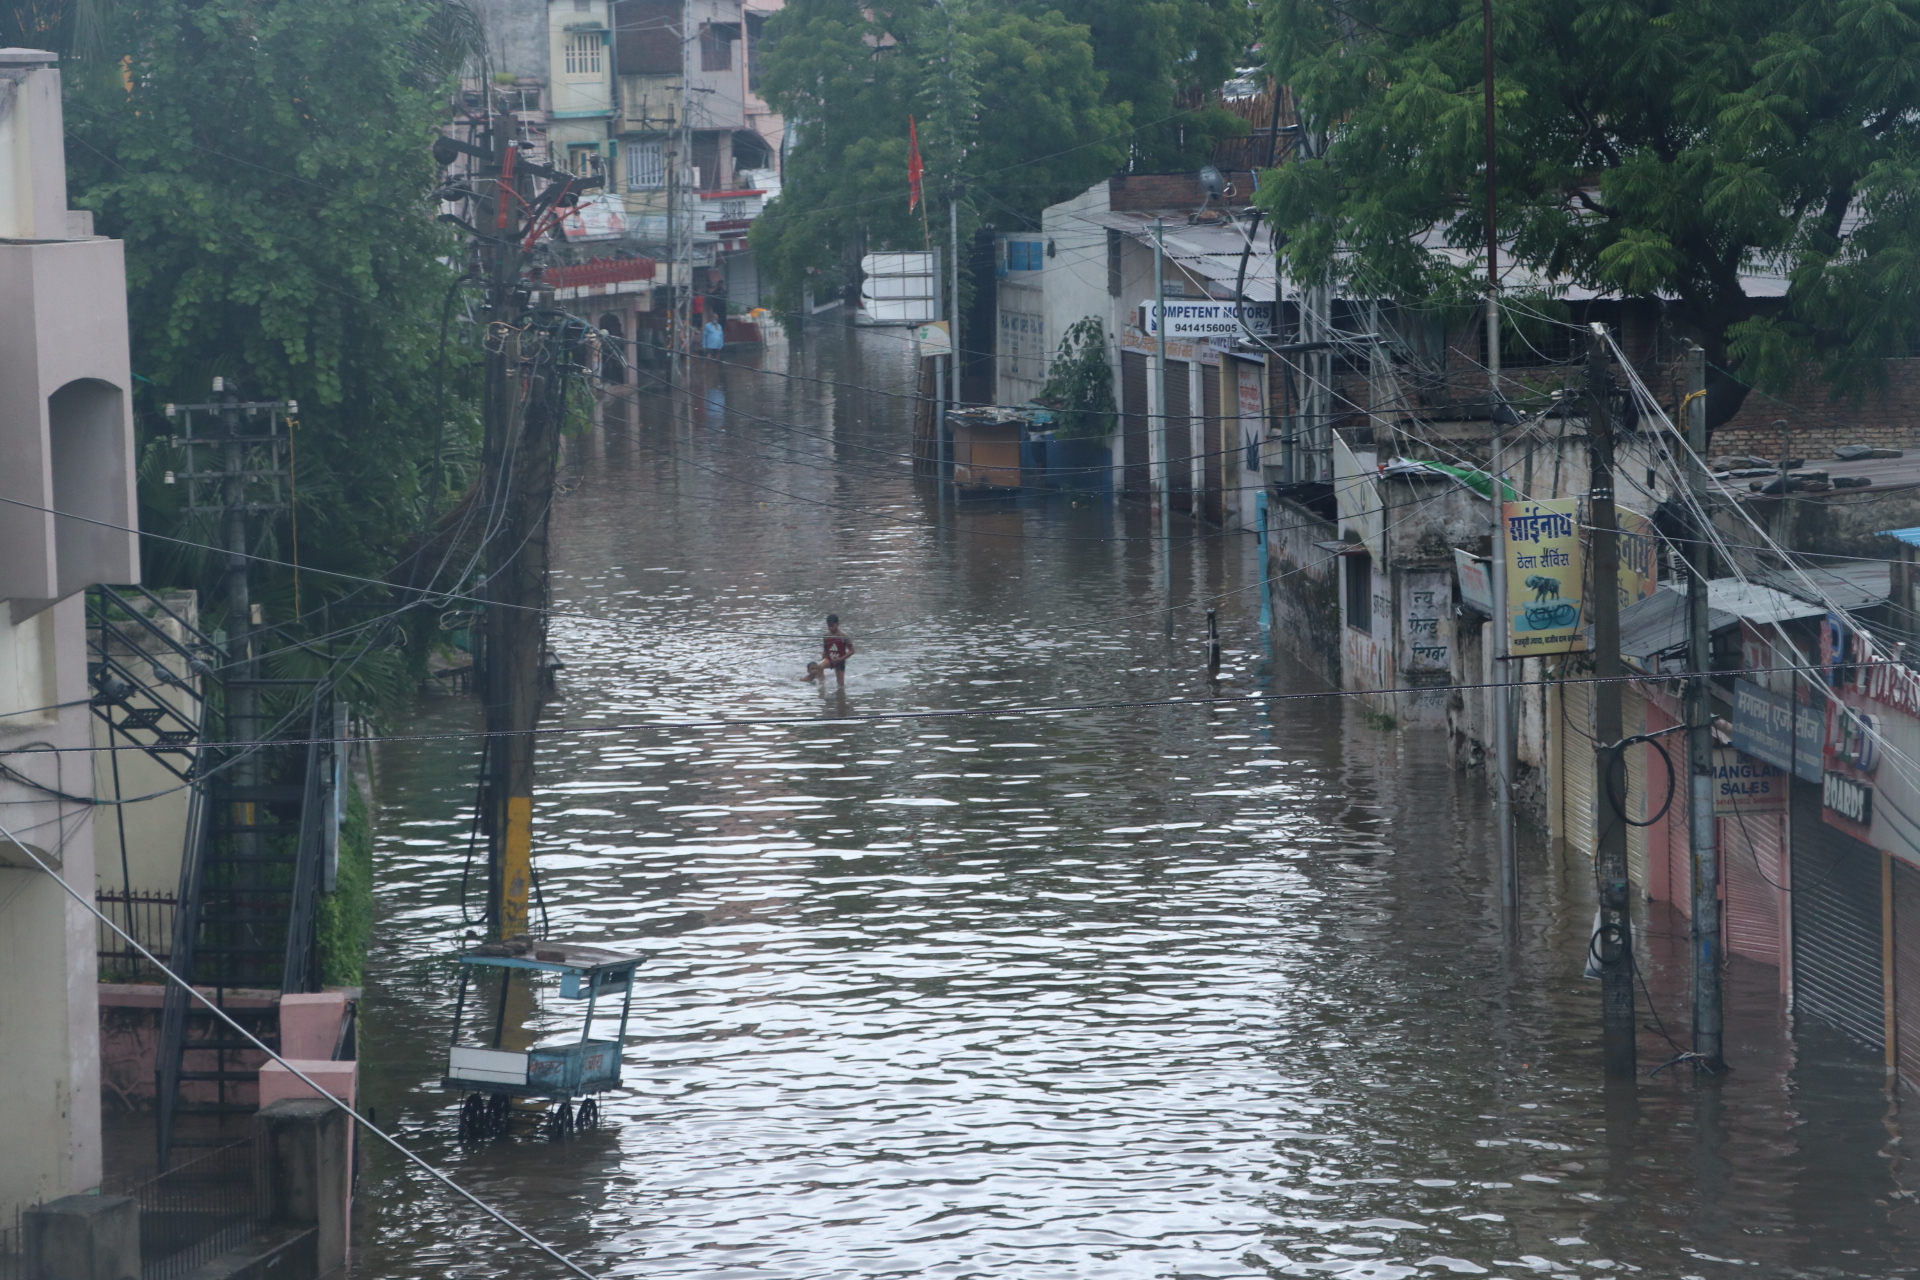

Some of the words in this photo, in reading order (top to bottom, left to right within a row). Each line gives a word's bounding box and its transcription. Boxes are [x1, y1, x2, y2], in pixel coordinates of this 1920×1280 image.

[1151, 305, 1219, 318] COMPETENT
[1223, 306, 1269, 319] MOTORS
[1174, 323, 1237, 333] 9414156005
[1517, 551, 1538, 569] ठेला
[1720, 781, 1770, 795] SALES
[1823, 773, 1865, 823] BOARDS
